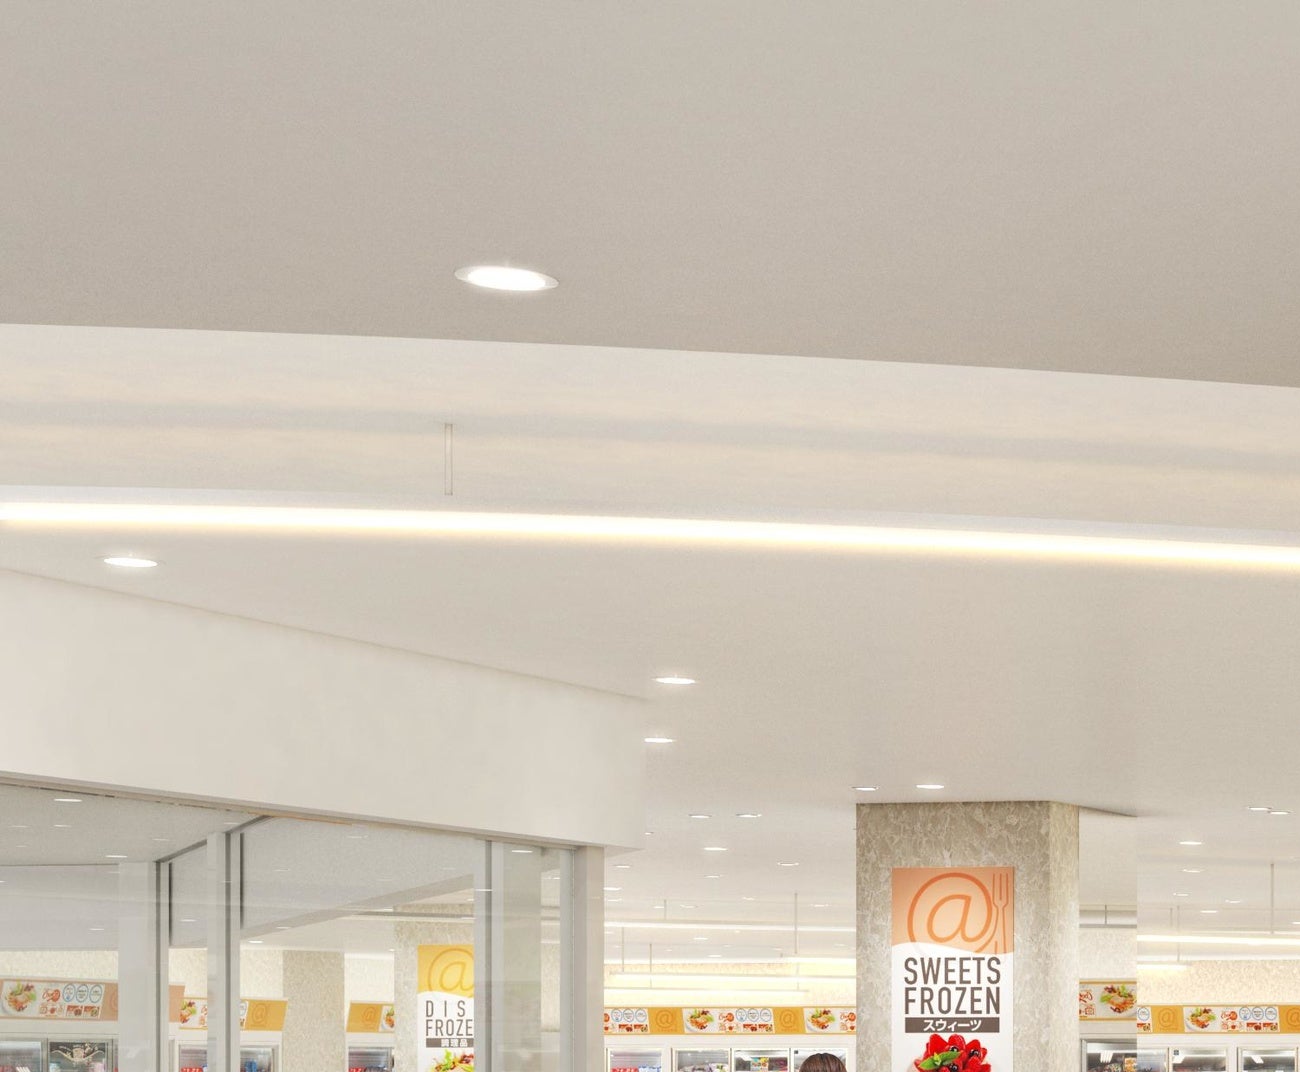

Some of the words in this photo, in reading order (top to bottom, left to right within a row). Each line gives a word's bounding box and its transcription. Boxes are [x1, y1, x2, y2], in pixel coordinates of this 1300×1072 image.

[904, 956, 1001, 985] SWEETS
[426, 1000, 466, 1018] DIS
[904, 986, 1000, 1015] FROZEN
[426, 1019, 473, 1036] FROZE
[923, 1019, 982, 1032] スウィーツ
